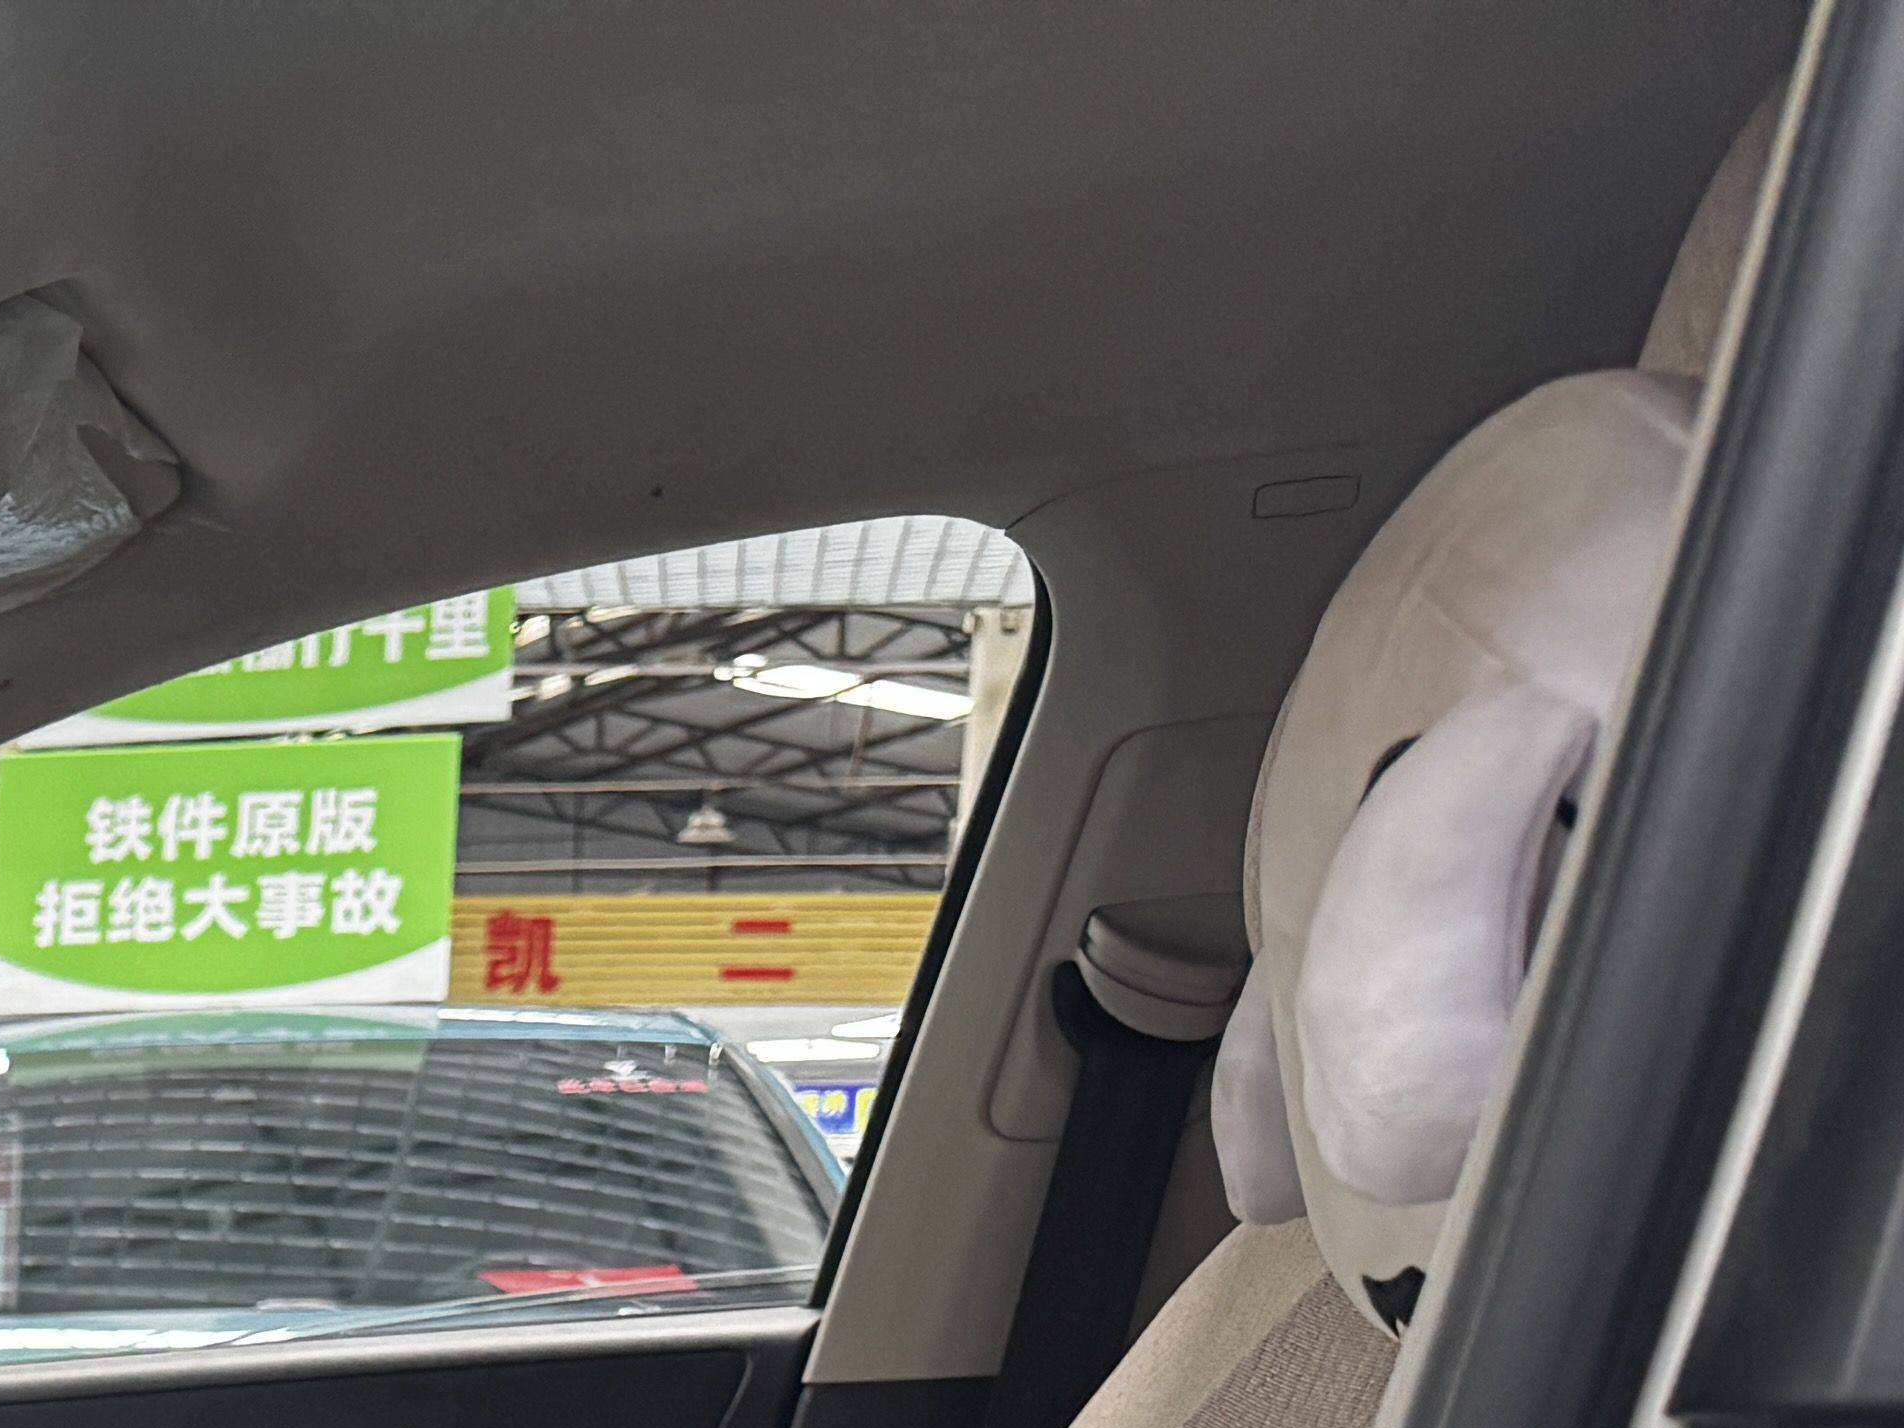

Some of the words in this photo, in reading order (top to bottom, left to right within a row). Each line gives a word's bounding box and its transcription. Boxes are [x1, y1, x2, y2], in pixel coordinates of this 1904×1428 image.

[85, 787, 378, 865] 铁件原版
[32, 868, 403, 948] 拒绝大事故
